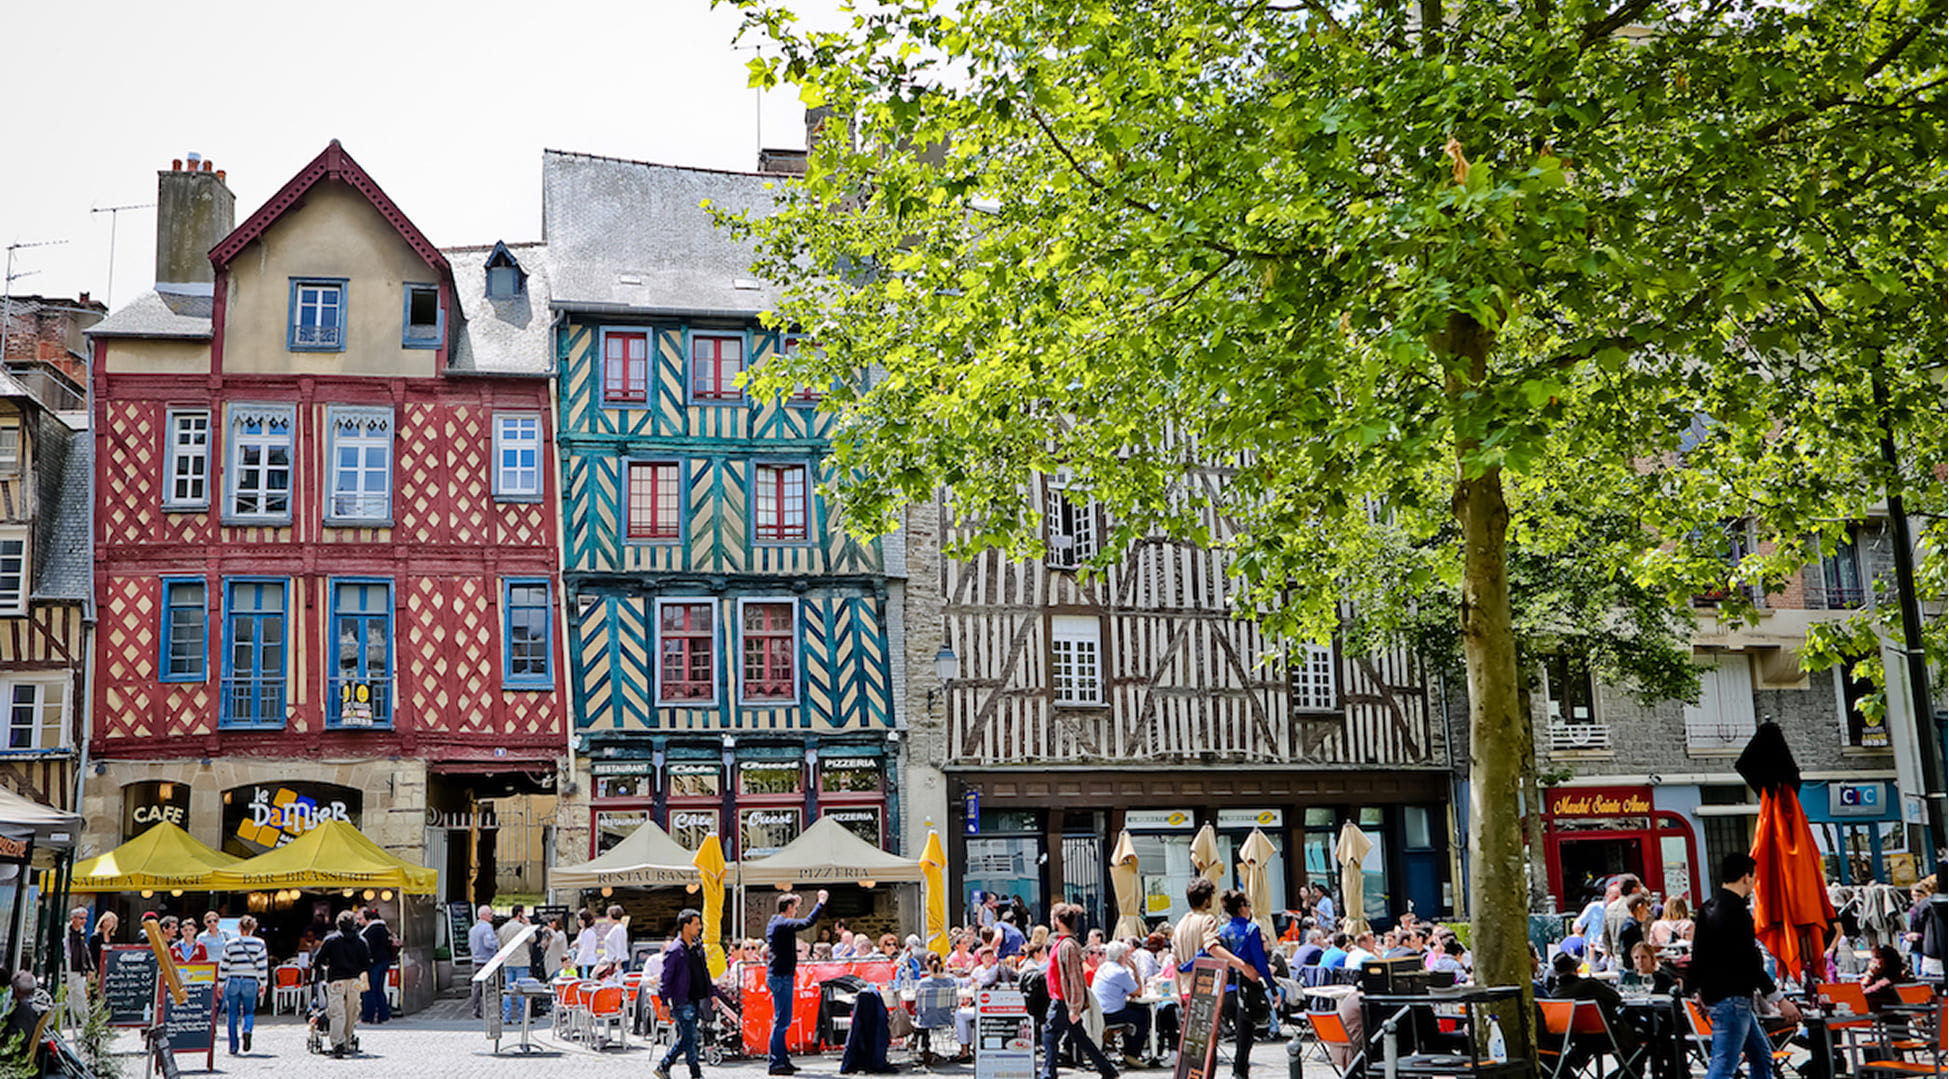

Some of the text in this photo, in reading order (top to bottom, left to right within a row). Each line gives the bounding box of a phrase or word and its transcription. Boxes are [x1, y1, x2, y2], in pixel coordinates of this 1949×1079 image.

[594, 764, 648, 773] RESTAURANT
[824, 758, 877, 768] PIZZERIA
[1842, 789, 1875, 804] CIC
[1553, 794, 1650, 815] Marché Sainte Anne
[748, 811, 793, 826] Ouest
[242, 870, 376, 884] BAR BRASSERIE
[598, 870, 700, 883] RESTAURANT
[800, 867, 869, 878] PIZZERIA
